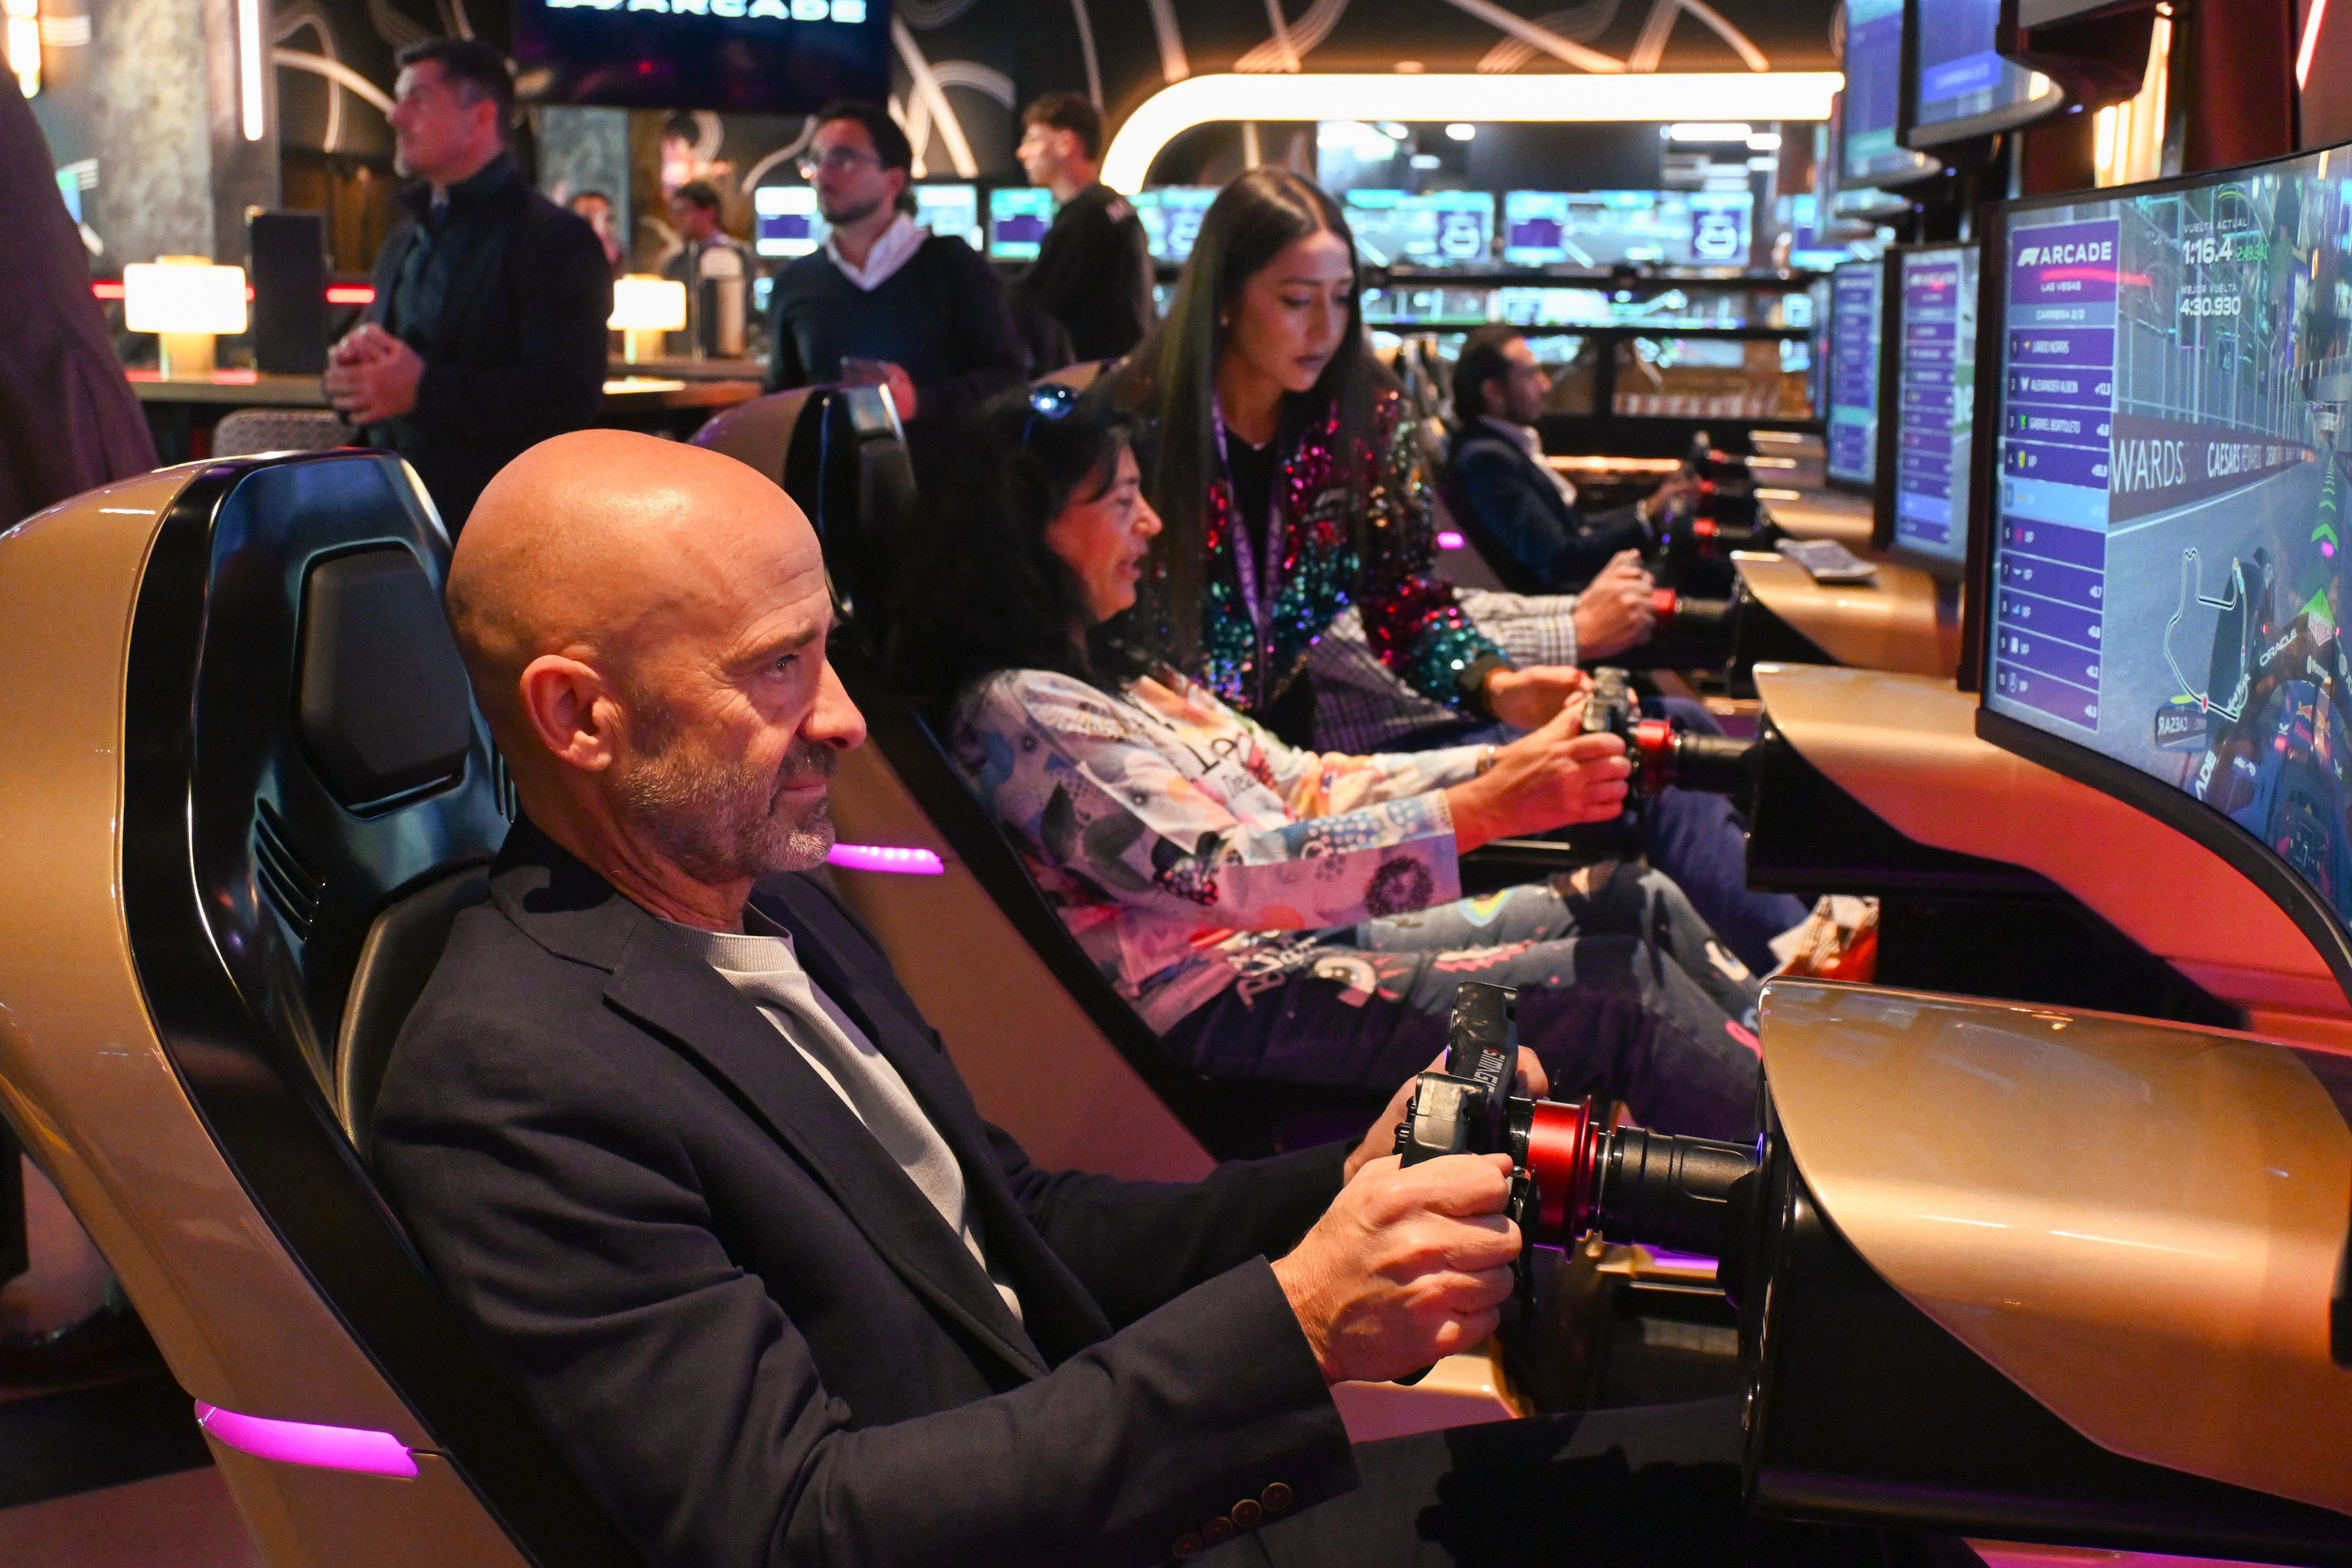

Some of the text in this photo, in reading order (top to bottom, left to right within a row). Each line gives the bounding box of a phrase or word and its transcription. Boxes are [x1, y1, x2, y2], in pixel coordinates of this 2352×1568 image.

[2183, 217, 2249, 234] VUELTA ACTUAL
[2040, 240, 2112, 266] ARCADE
[2183, 237, 2233, 266] 1:16.4
[2040, 281, 2081, 293] LAS VEGAS
[2209, 283, 2237, 294] VUELTA
[2179, 296, 2242, 317] 4:30.930
[2207, 442, 2241, 479] CAESARS
[2259, 628, 2298, 667] ORACLE
